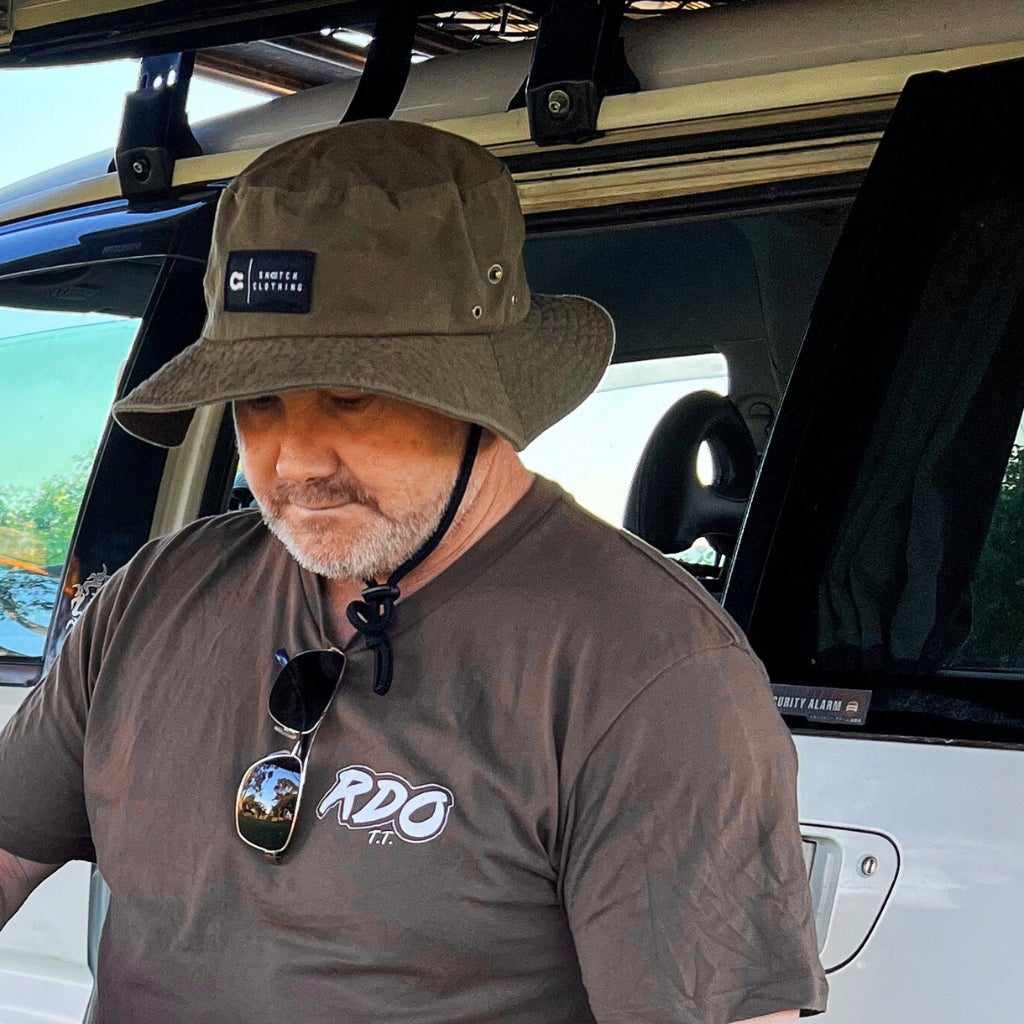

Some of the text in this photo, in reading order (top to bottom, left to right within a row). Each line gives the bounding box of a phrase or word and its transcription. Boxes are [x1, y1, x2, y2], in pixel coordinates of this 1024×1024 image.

[252, 282, 303, 292] CLOTHING
[774, 696, 842, 712] URITY ALARM
[317, 767, 451, 840] RDO
